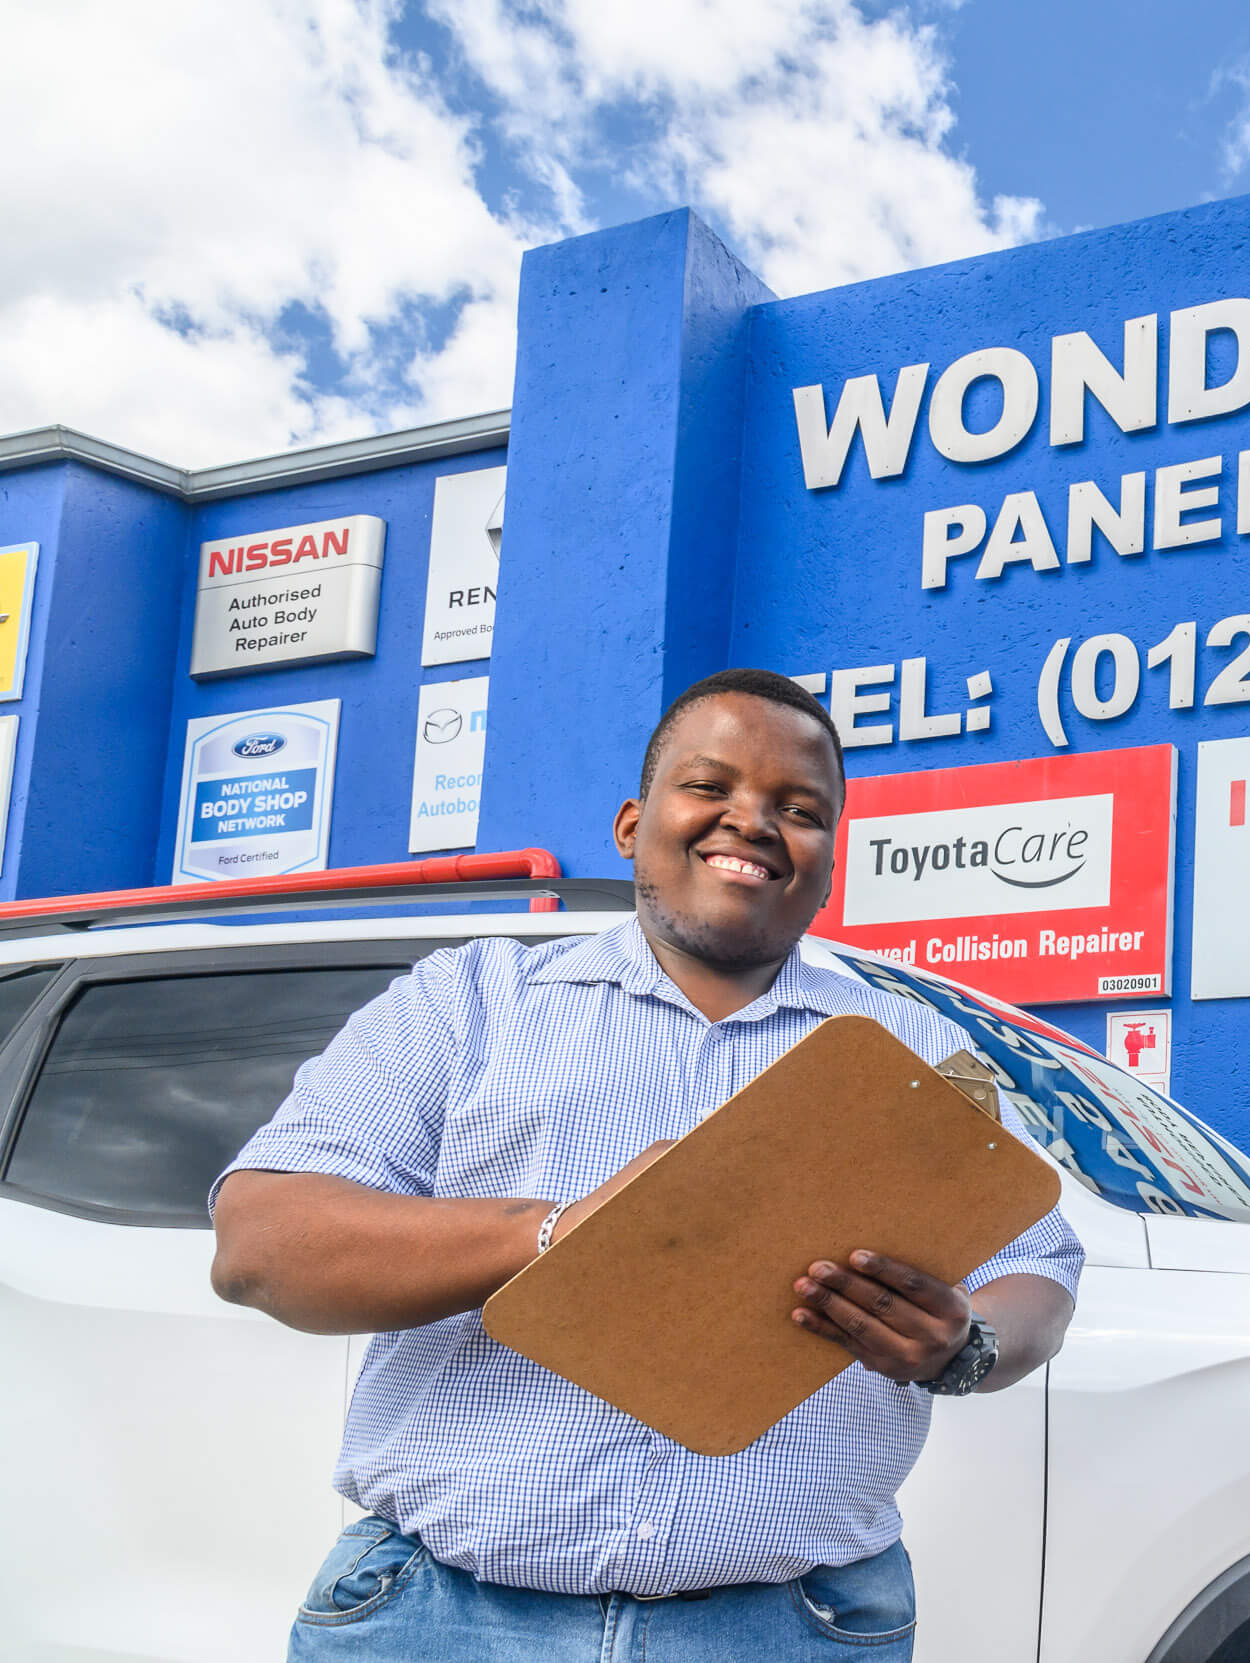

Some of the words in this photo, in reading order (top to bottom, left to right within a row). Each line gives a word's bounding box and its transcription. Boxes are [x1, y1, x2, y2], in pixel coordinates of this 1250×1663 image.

[208, 529, 349, 577] NISSAN
[228, 584, 321, 612] Authorised
[229, 617, 268, 632] Auto
[274, 607, 318, 625] Body
[235, 631, 307, 652] Repairer
[433, 625, 478, 641] Approved
[480, 624, 494, 634] Bo
[242, 735, 278, 755] Ford
[221, 777, 289, 796] NATIONAL
[201, 798, 253, 819] BODY
[254, 791, 307, 813] SHOP
[417, 797, 480, 818] Autobo
[218, 814, 287, 832] NETWORK
[218, 855, 239, 865] Ford
[240, 851, 279, 863] Certified
[926, 936, 1028, 964] Collision
[1039, 928, 1145, 960] Repairer
[1102, 977, 1158, 991] 03020901
